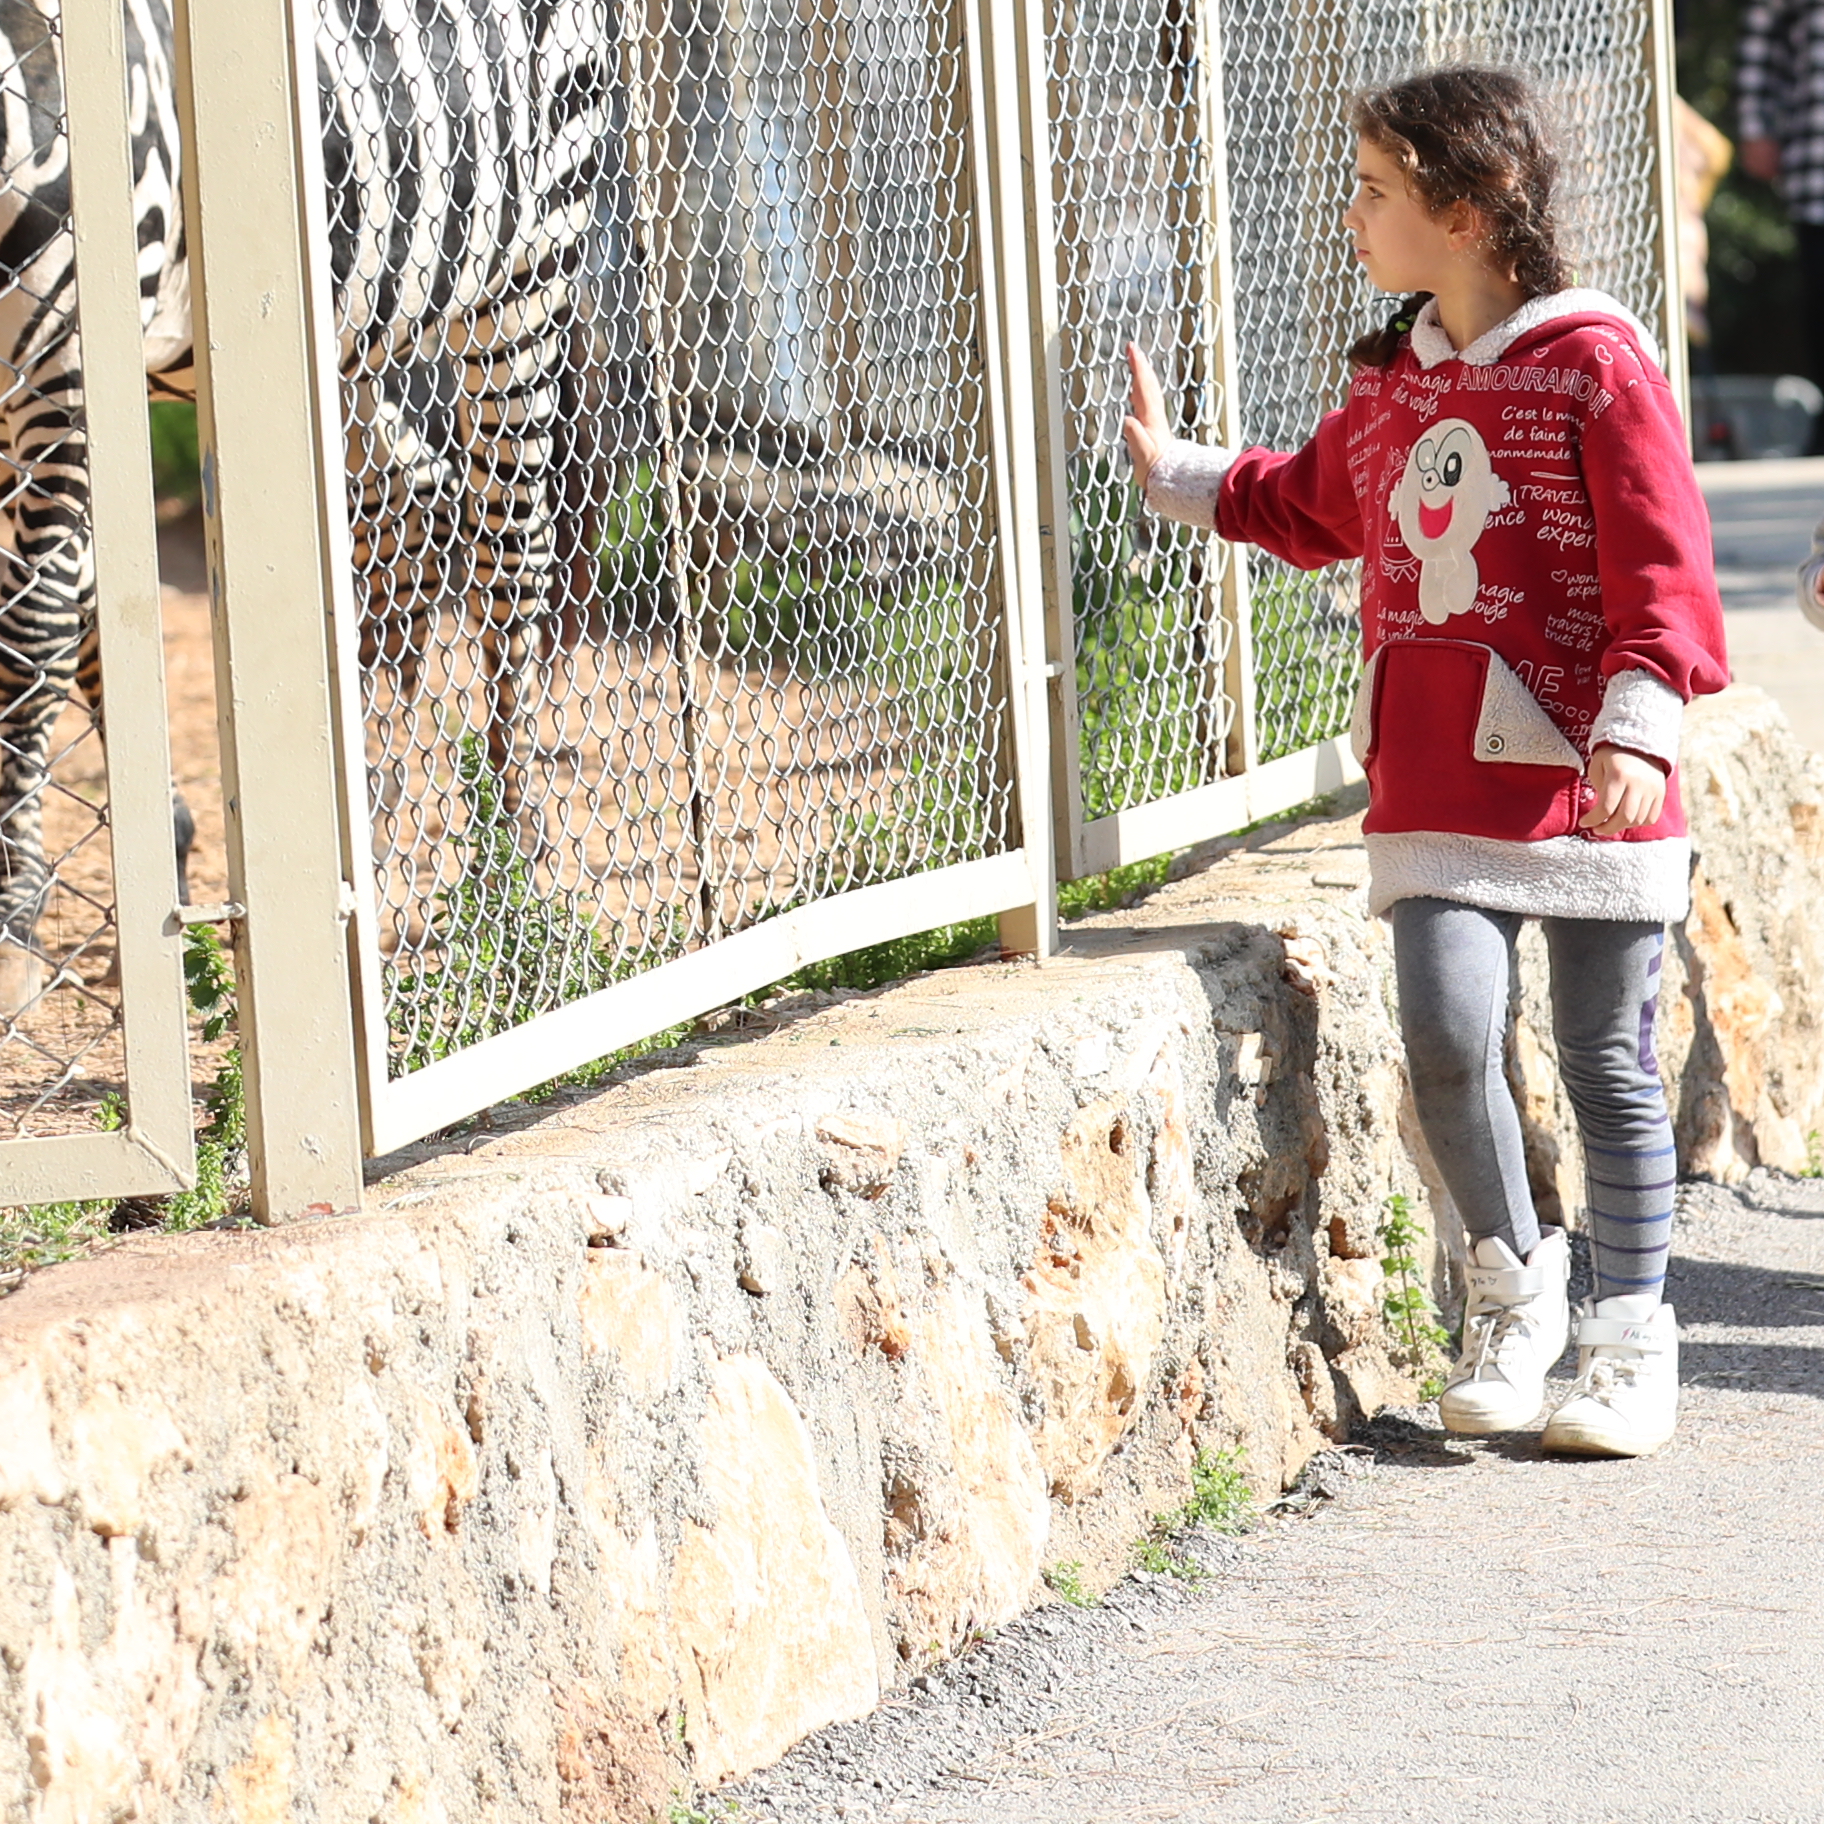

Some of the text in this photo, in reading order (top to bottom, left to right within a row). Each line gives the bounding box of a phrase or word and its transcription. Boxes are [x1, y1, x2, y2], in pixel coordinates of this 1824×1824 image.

[1501, 405, 1538, 421] C'est
[1542, 407, 1553, 421] le
[1503, 425, 1524, 441] de
[1529, 425, 1566, 443] faine
